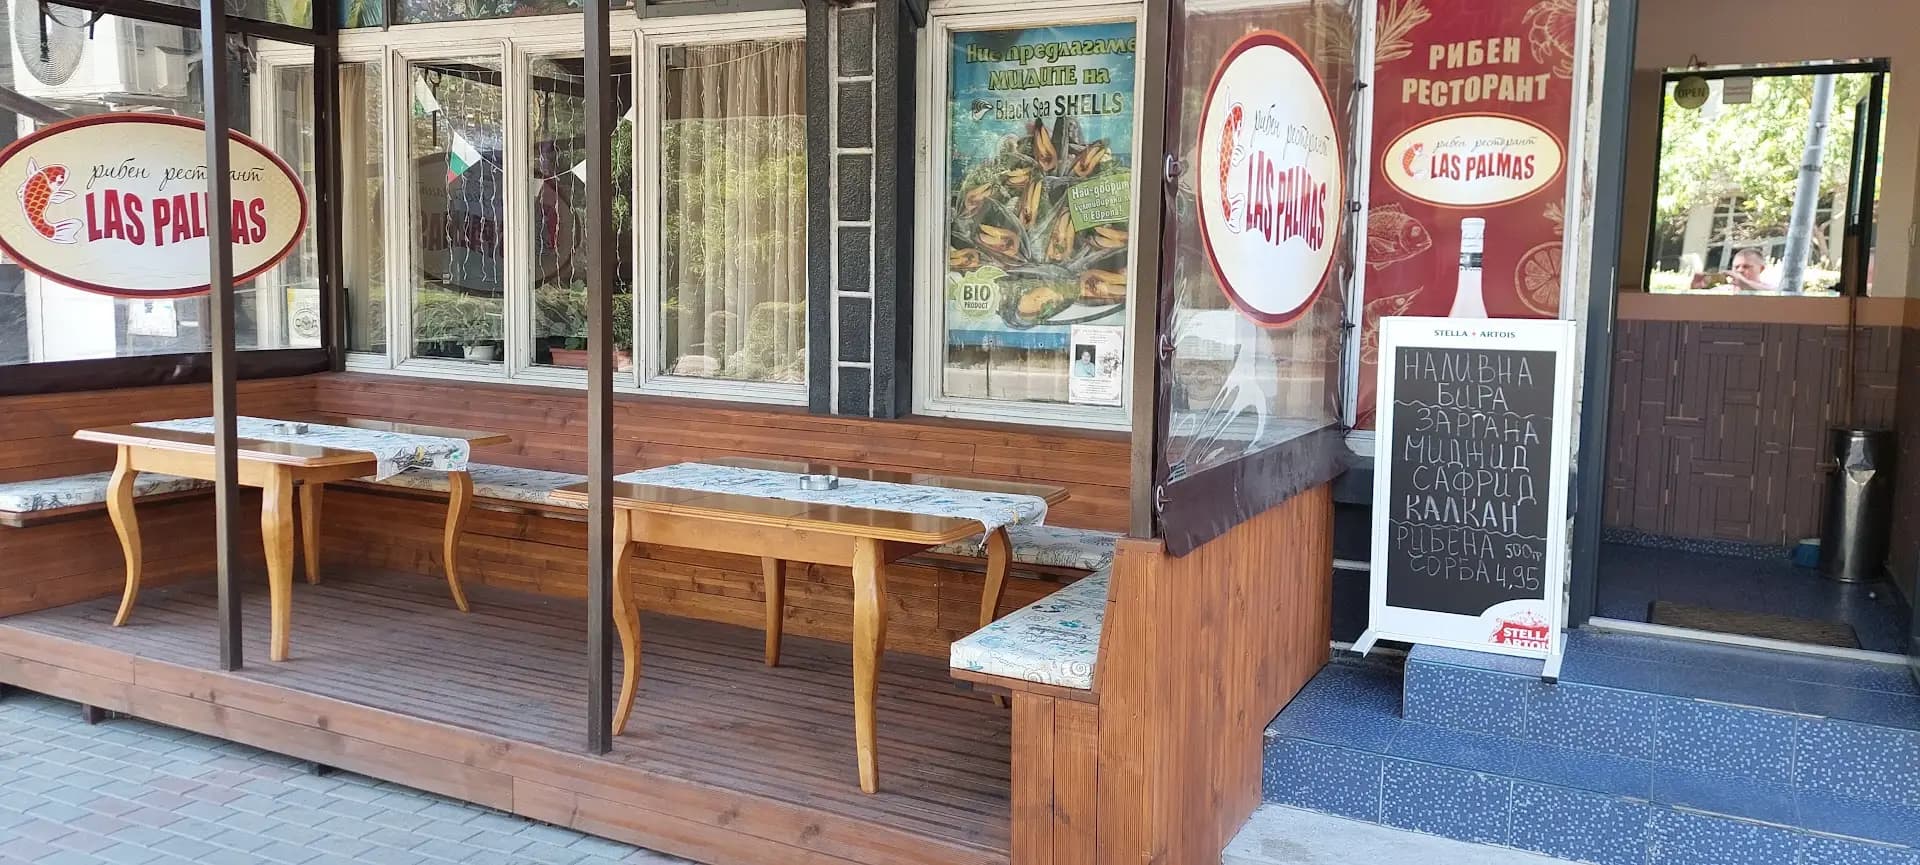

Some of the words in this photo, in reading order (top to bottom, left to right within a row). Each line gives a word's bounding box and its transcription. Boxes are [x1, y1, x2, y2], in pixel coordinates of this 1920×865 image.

[1005, 36, 1136, 66] предлагаме
[1429, 36, 1521, 71] РИБЕН
[987, 65, 1077, 90] МИДИТЕ
[1082, 67, 1110, 85] на
[1401, 73, 1552, 107] РЕСТОРАНТ
[1678, 87, 1706, 98] OPEN
[995, 98, 1030, 121] Black
[1032, 96, 1050, 118] Sea
[1054, 92, 1123, 116] SHELLS
[1250, 104, 1280, 148] рибен
[1433, 136, 1466, 153] рибен
[1471, 136, 1537, 152] ресторант
[86, 158, 150, 190] рибен
[1430, 152, 1461, 181] LAS
[1466, 152, 1535, 181] PALMAS
[1246, 150, 1274, 243] LAS
[1275, 165, 1326, 252] PALMAS
[85, 189, 146, 245] LAS
[152, 191, 267, 246] PALAS
[963, 285, 991, 301] BIO
[1434, 329, 1468, 337] STELLA
[1480, 331, 1516, 339] ARTOIS
[1403, 350, 1534, 387] НАЛИВНА
[1437, 382, 1509, 412] БИРА
[1415, 407, 1539, 445] ЗАРГАНА
[1412, 465, 1537, 507] САФРИД
[1406, 494, 1518, 534] КАЛКАН
[1396, 525, 1495, 560] РИБЕНА
[1495, 562, 1540, 590] 4,95
